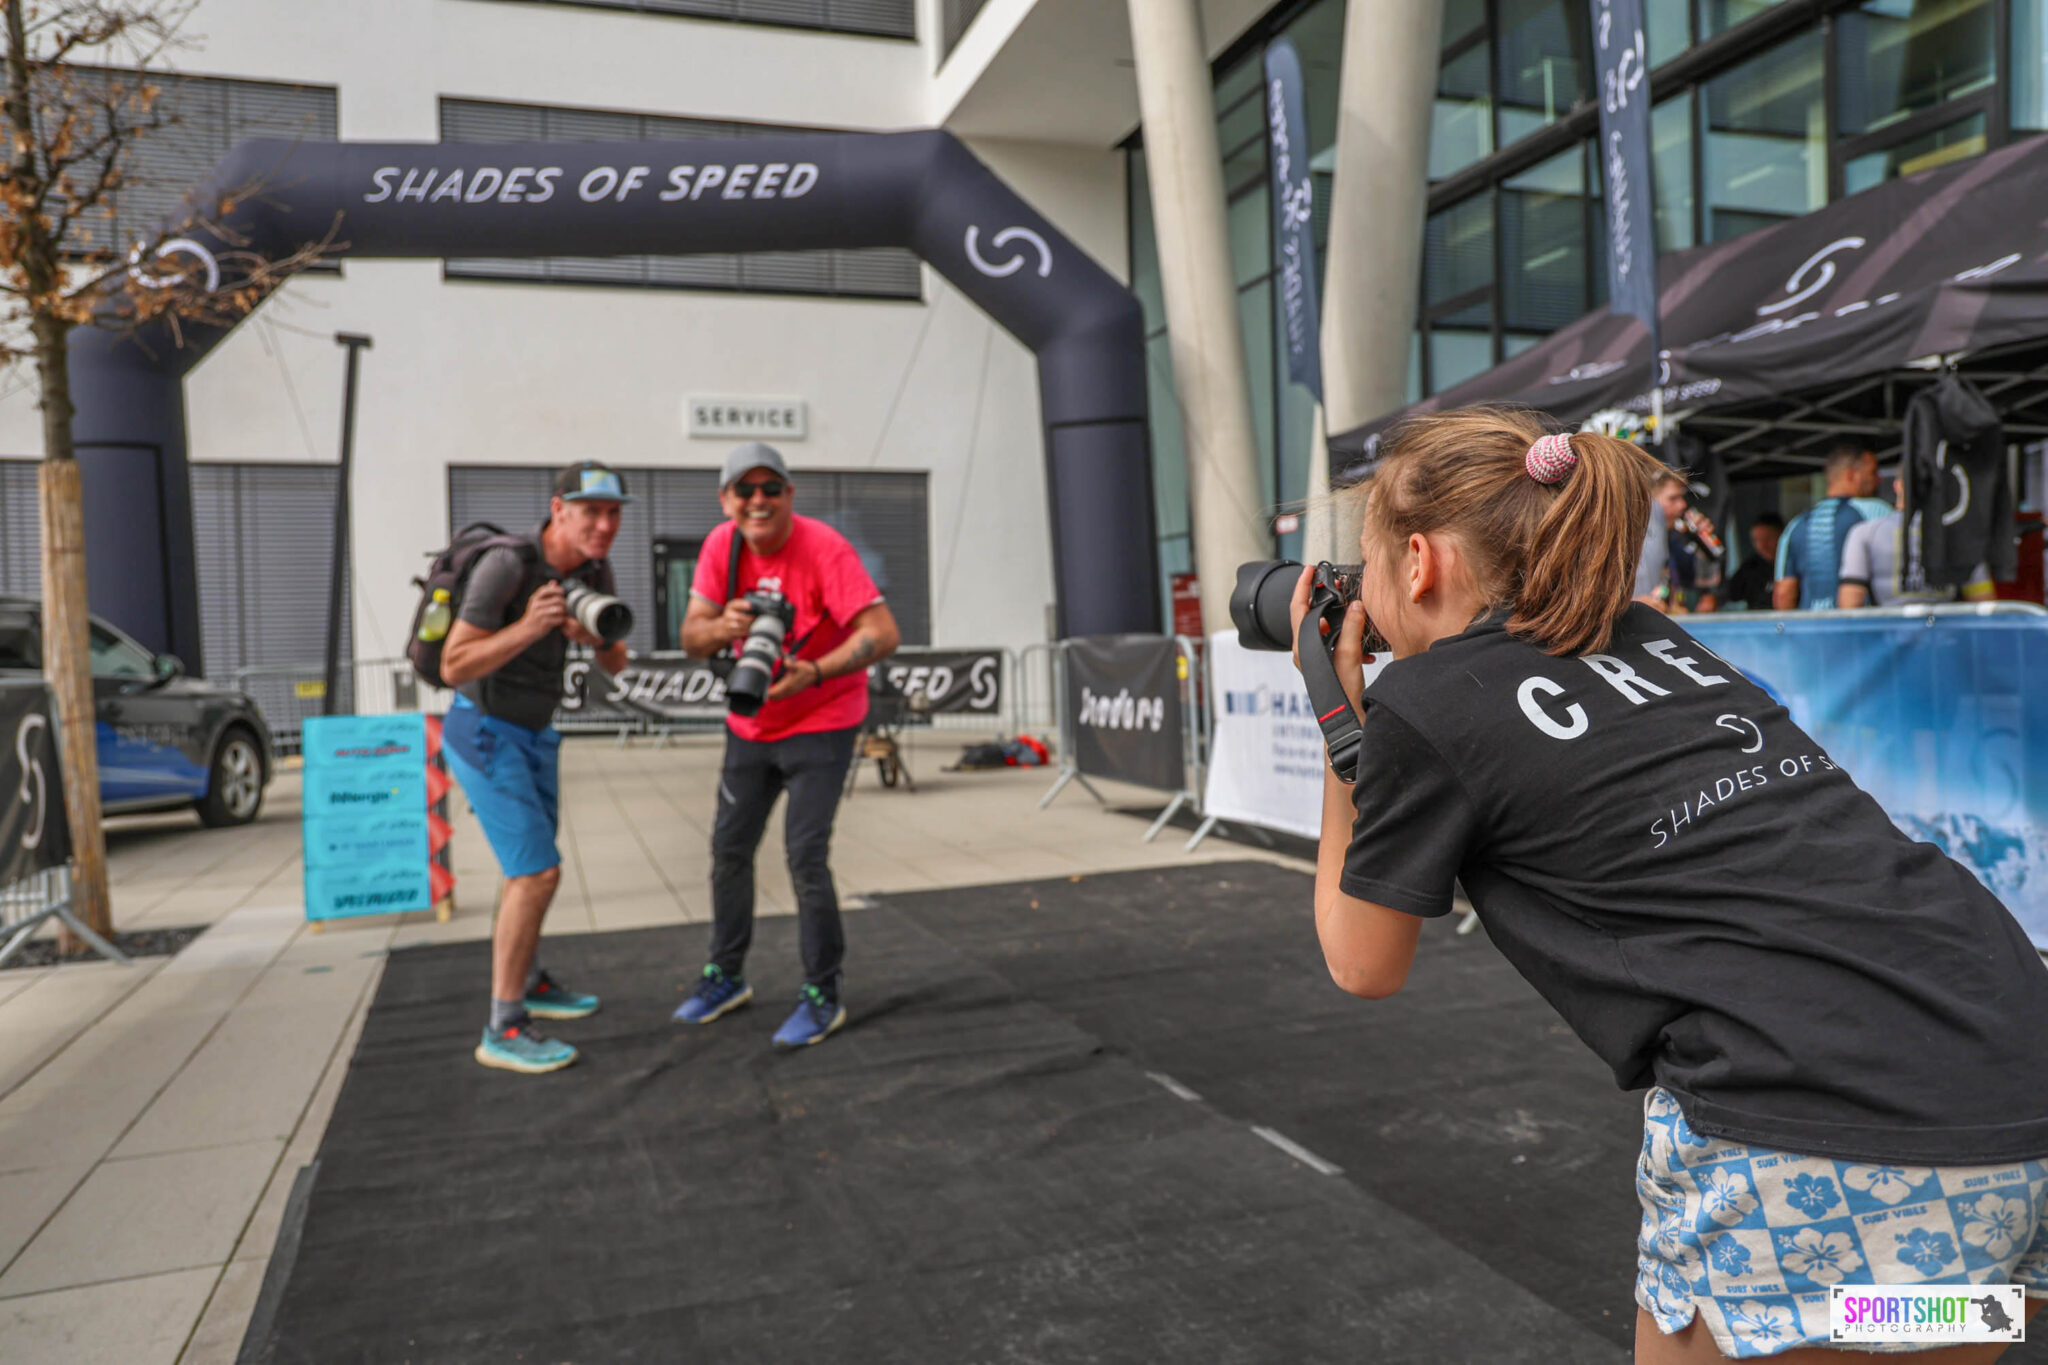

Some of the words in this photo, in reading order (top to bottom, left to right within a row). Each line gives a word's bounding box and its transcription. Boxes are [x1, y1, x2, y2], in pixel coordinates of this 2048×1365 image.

[364, 166, 563, 203] SHADES
[578, 166, 650, 202] OF
[660, 162, 820, 201] SPEED
[695, 406, 795, 428] SERVICE
[606, 668, 728, 702] SHADE
[1517, 638, 1745, 740] CRE
[1650, 765, 1768, 848] SHADES
[1779, 754, 1812, 777] OF
[1756, 1157, 1779, 1169] SURF
[1963, 1175, 1990, 1188] SURF
[1993, 1169, 2022, 1183] VIBES
[1861, 1211, 1889, 1225] SURF
[1892, 1204, 1928, 1219] VIBES
[1726, 1284, 1748, 1294] SURF
[1752, 1283, 1780, 1293] VIBES
